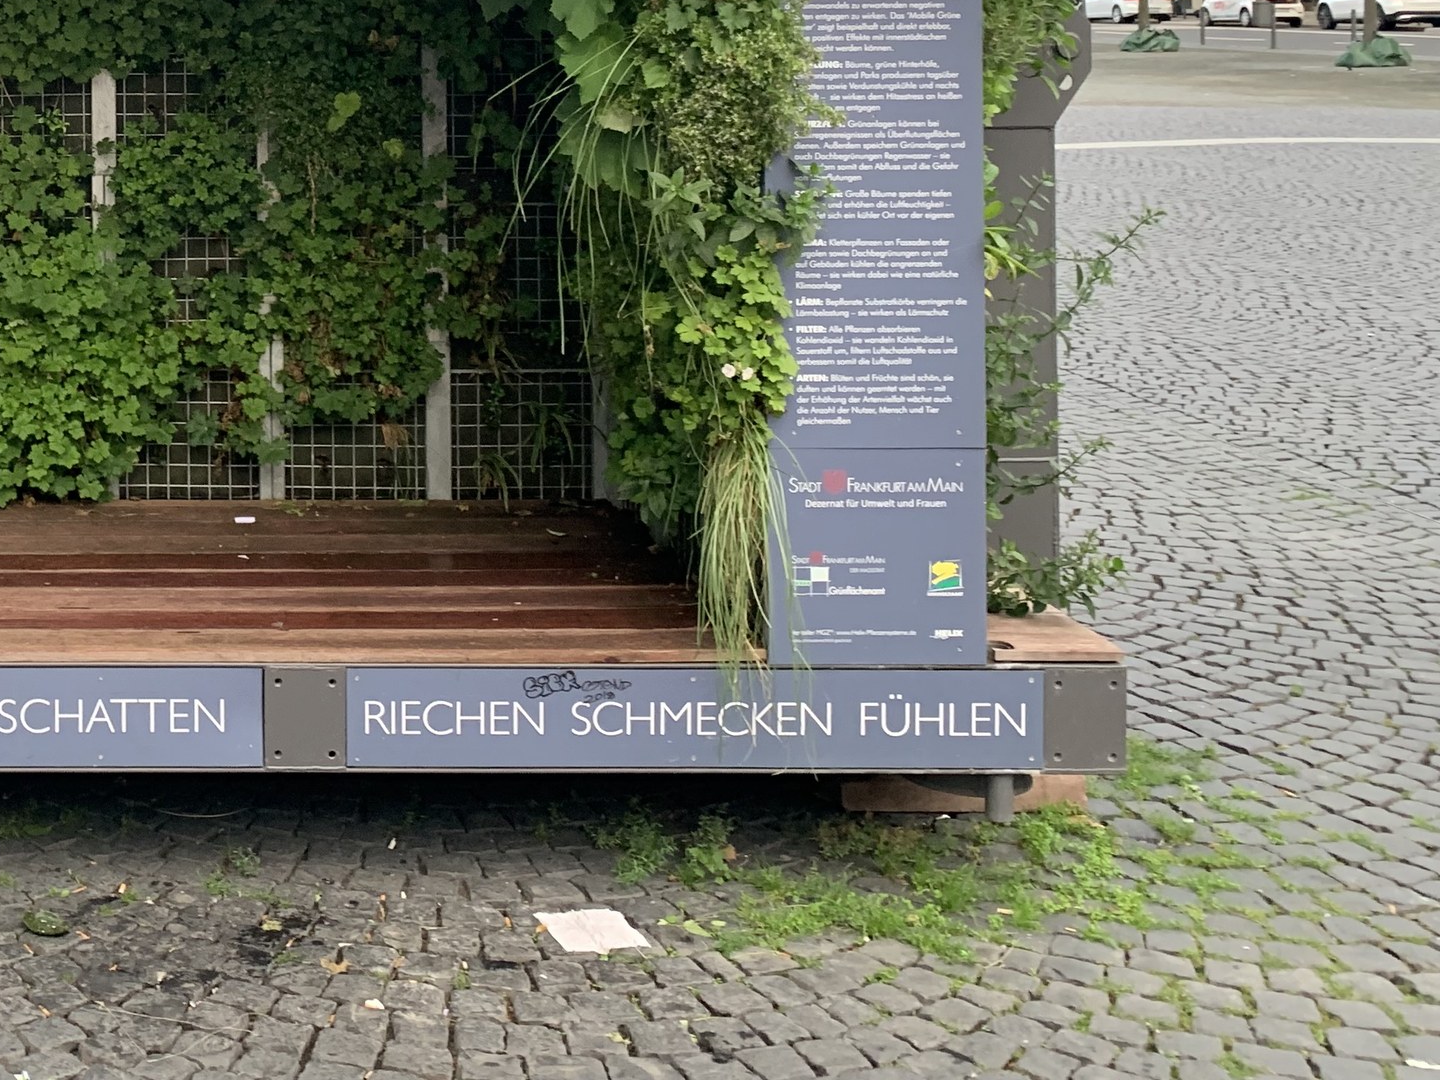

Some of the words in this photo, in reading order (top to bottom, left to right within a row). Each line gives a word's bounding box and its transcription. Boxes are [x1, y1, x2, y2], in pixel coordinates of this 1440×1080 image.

[812, 34, 844, 43] positiven
[846, 33, 870, 41] Effekte
[886, 92, 924, 100] Hitzestress
[936, 92, 962, 100] heißen
[847, 120, 896, 130] Grünanlagen
[823, 141, 861, 149] Außerdem
[863, 141, 898, 151] speichern
[900, 141, 949, 150] Grünanlagen
[815, 152, 882, 162] Dachbegrünungen
[884, 152, 931, 161] Regenwasser
[899, 190, 930, 199] spenden
[890, 200, 944, 210] Luftfeuchtigkeit
[857, 211, 880, 219] kühler
[882, 211, 895, 219] Ort
[910, 211, 923, 219] der
[925, 211, 954, 220] eigenen
[829, 239, 882, 248] Kletterpflanzen
[896, 238, 930, 246] Fassaden
[932, 238, 949, 246] oder
[852, 249, 919, 258] Dachbegrünungen
[795, 260, 808, 268] auf
[809, 260, 849, 268] Gebäuden
[890, 260, 943, 269] angrenzenden
[922, 270, 959, 278] natürliche
[796, 282, 841, 291] Klimaanlage
[796, 297, 823, 306] LÄRM:
[825, 298, 863, 308] Bepflanzte
[917, 298, 954, 307] verringern
[955, 297, 967, 305] die
[796, 309, 849, 319] Lärmbelastung
[908, 308, 949, 316] Lärmschutz
[829, 325, 843, 333] Alle
[845, 325, 875, 333] Pflanzen
[877, 325, 920, 333] absorbieren
[796, 336, 843, 344] Kohlendioxid
[796, 347, 832, 355] Sauerstoff
[943, 346, 957, 354] und
[872, 357, 912, 367] Luftqualität
[796, 374, 829, 382] ARTEN:
[831, 374, 854, 382] Blüten
[855, 374, 870, 382] und
[872, 374, 898, 382] Früchte
[917, 374, 941, 382] schön,
[797, 385, 820, 393] duften
[822, 385, 836, 393] und
[867, 385, 898, 394] geerntet
[898, 384, 926, 392] werden
[811, 396, 846, 405] Erhöhung
[862, 395, 905, 403] Artenvielfalt
[907, 395, 932, 403] wächst
[933, 395, 952, 403] auch
[797, 406, 809, 414] die
[810, 406, 835, 414] Anzahl
[837, 406, 850, 414] der
[851, 406, 877, 415] Nutzer,
[797, 417, 851, 427] gleichermaßen
[789, 477, 822, 493] STADT
[847, 478, 906, 492] FRANKFURT
[926, 478, 963, 492] MAIN
[805, 499, 844, 507] Dezernat
[846, 499, 859, 507] für
[861, 499, 895, 507] Umwelt
[897, 499, 914, 507] und
[916, 499, 947, 507] Frauen
[365, 701, 544, 735] RIECHEN
[572, 702, 831, 735] SCHMECKEN
[861, 694, 1025, 736] FÜHLEN
